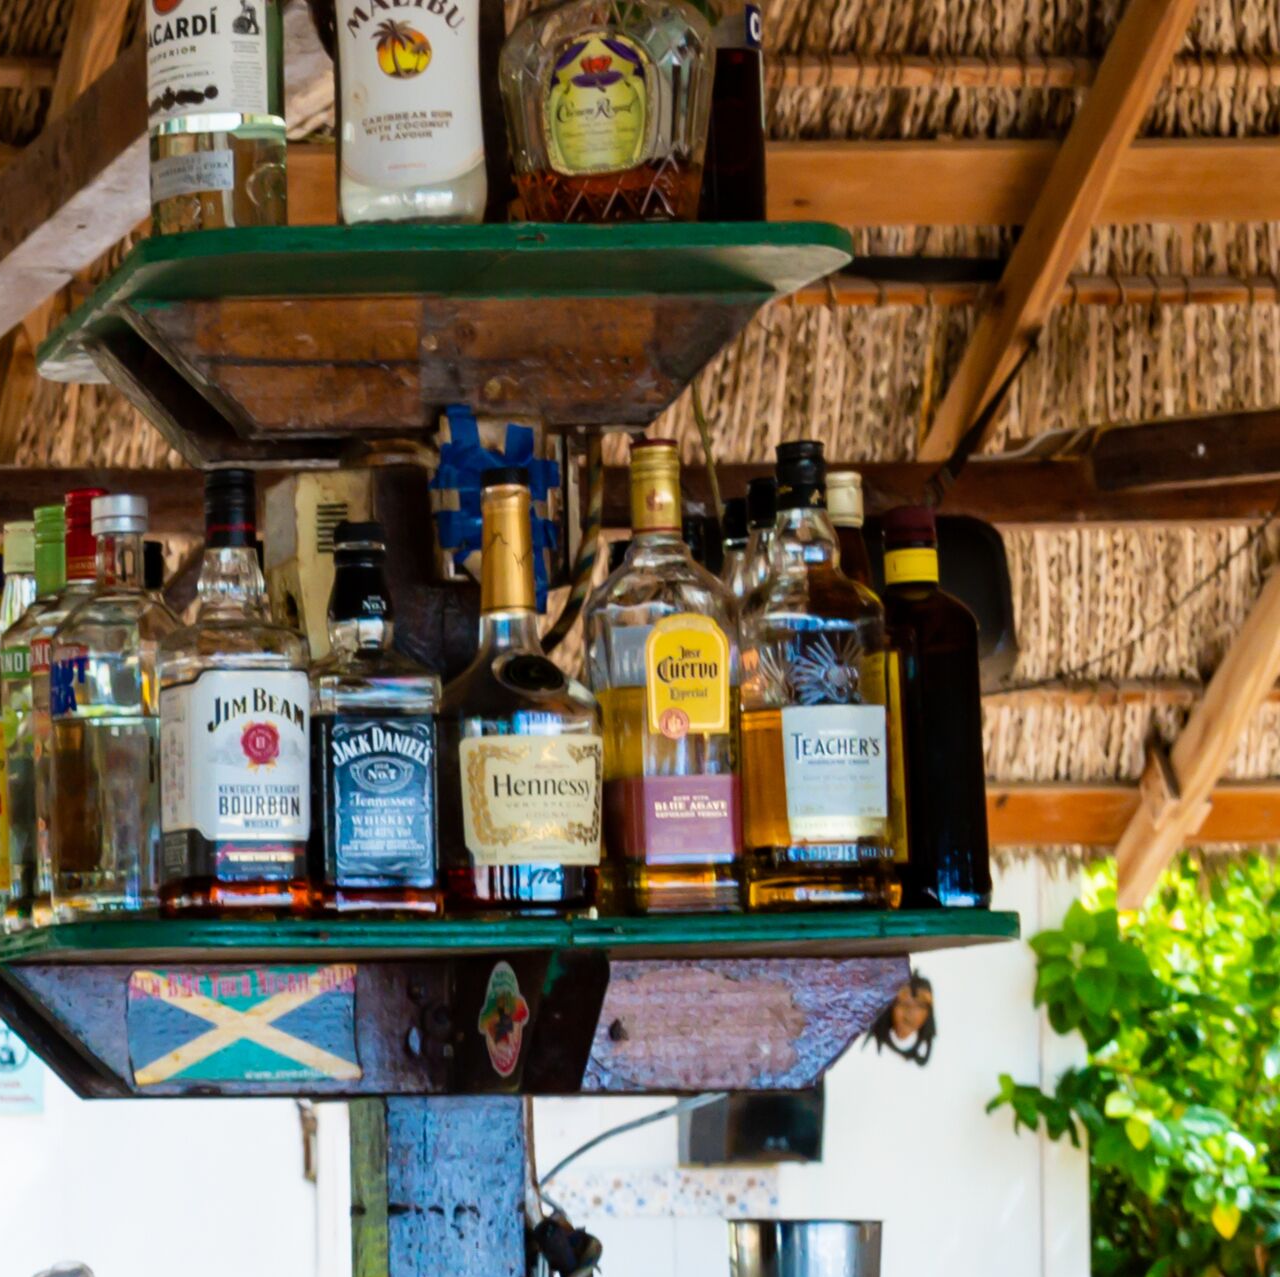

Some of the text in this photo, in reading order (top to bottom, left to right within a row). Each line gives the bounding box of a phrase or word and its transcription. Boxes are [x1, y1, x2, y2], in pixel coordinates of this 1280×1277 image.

[148, 6, 218, 48] ACARDÍ
[362, 111, 427, 127] CARIBBEAN
[365, 120, 450, 137] WITH COCONUT
[379, 130, 433, 143] FLAVOUR
[657, 656, 718, 683] Cuervo
[207, 688, 305, 734] JIM BEAM
[332, 727, 432, 767] JACK DANIEL'S
[791, 733, 880, 760] TEACHER'S
[218, 784, 300, 795] KENTUCKY STRAIGHT
[493, 774, 590, 801] Hennessy
[218, 796, 300, 817] BOURBON
[349, 792, 416, 807] Tennessee
[654, 801, 728, 811] BLUE AGAVE
[243, 818, 280, 829] WHISKEY
[351, 815, 415, 826] WHISKEY
